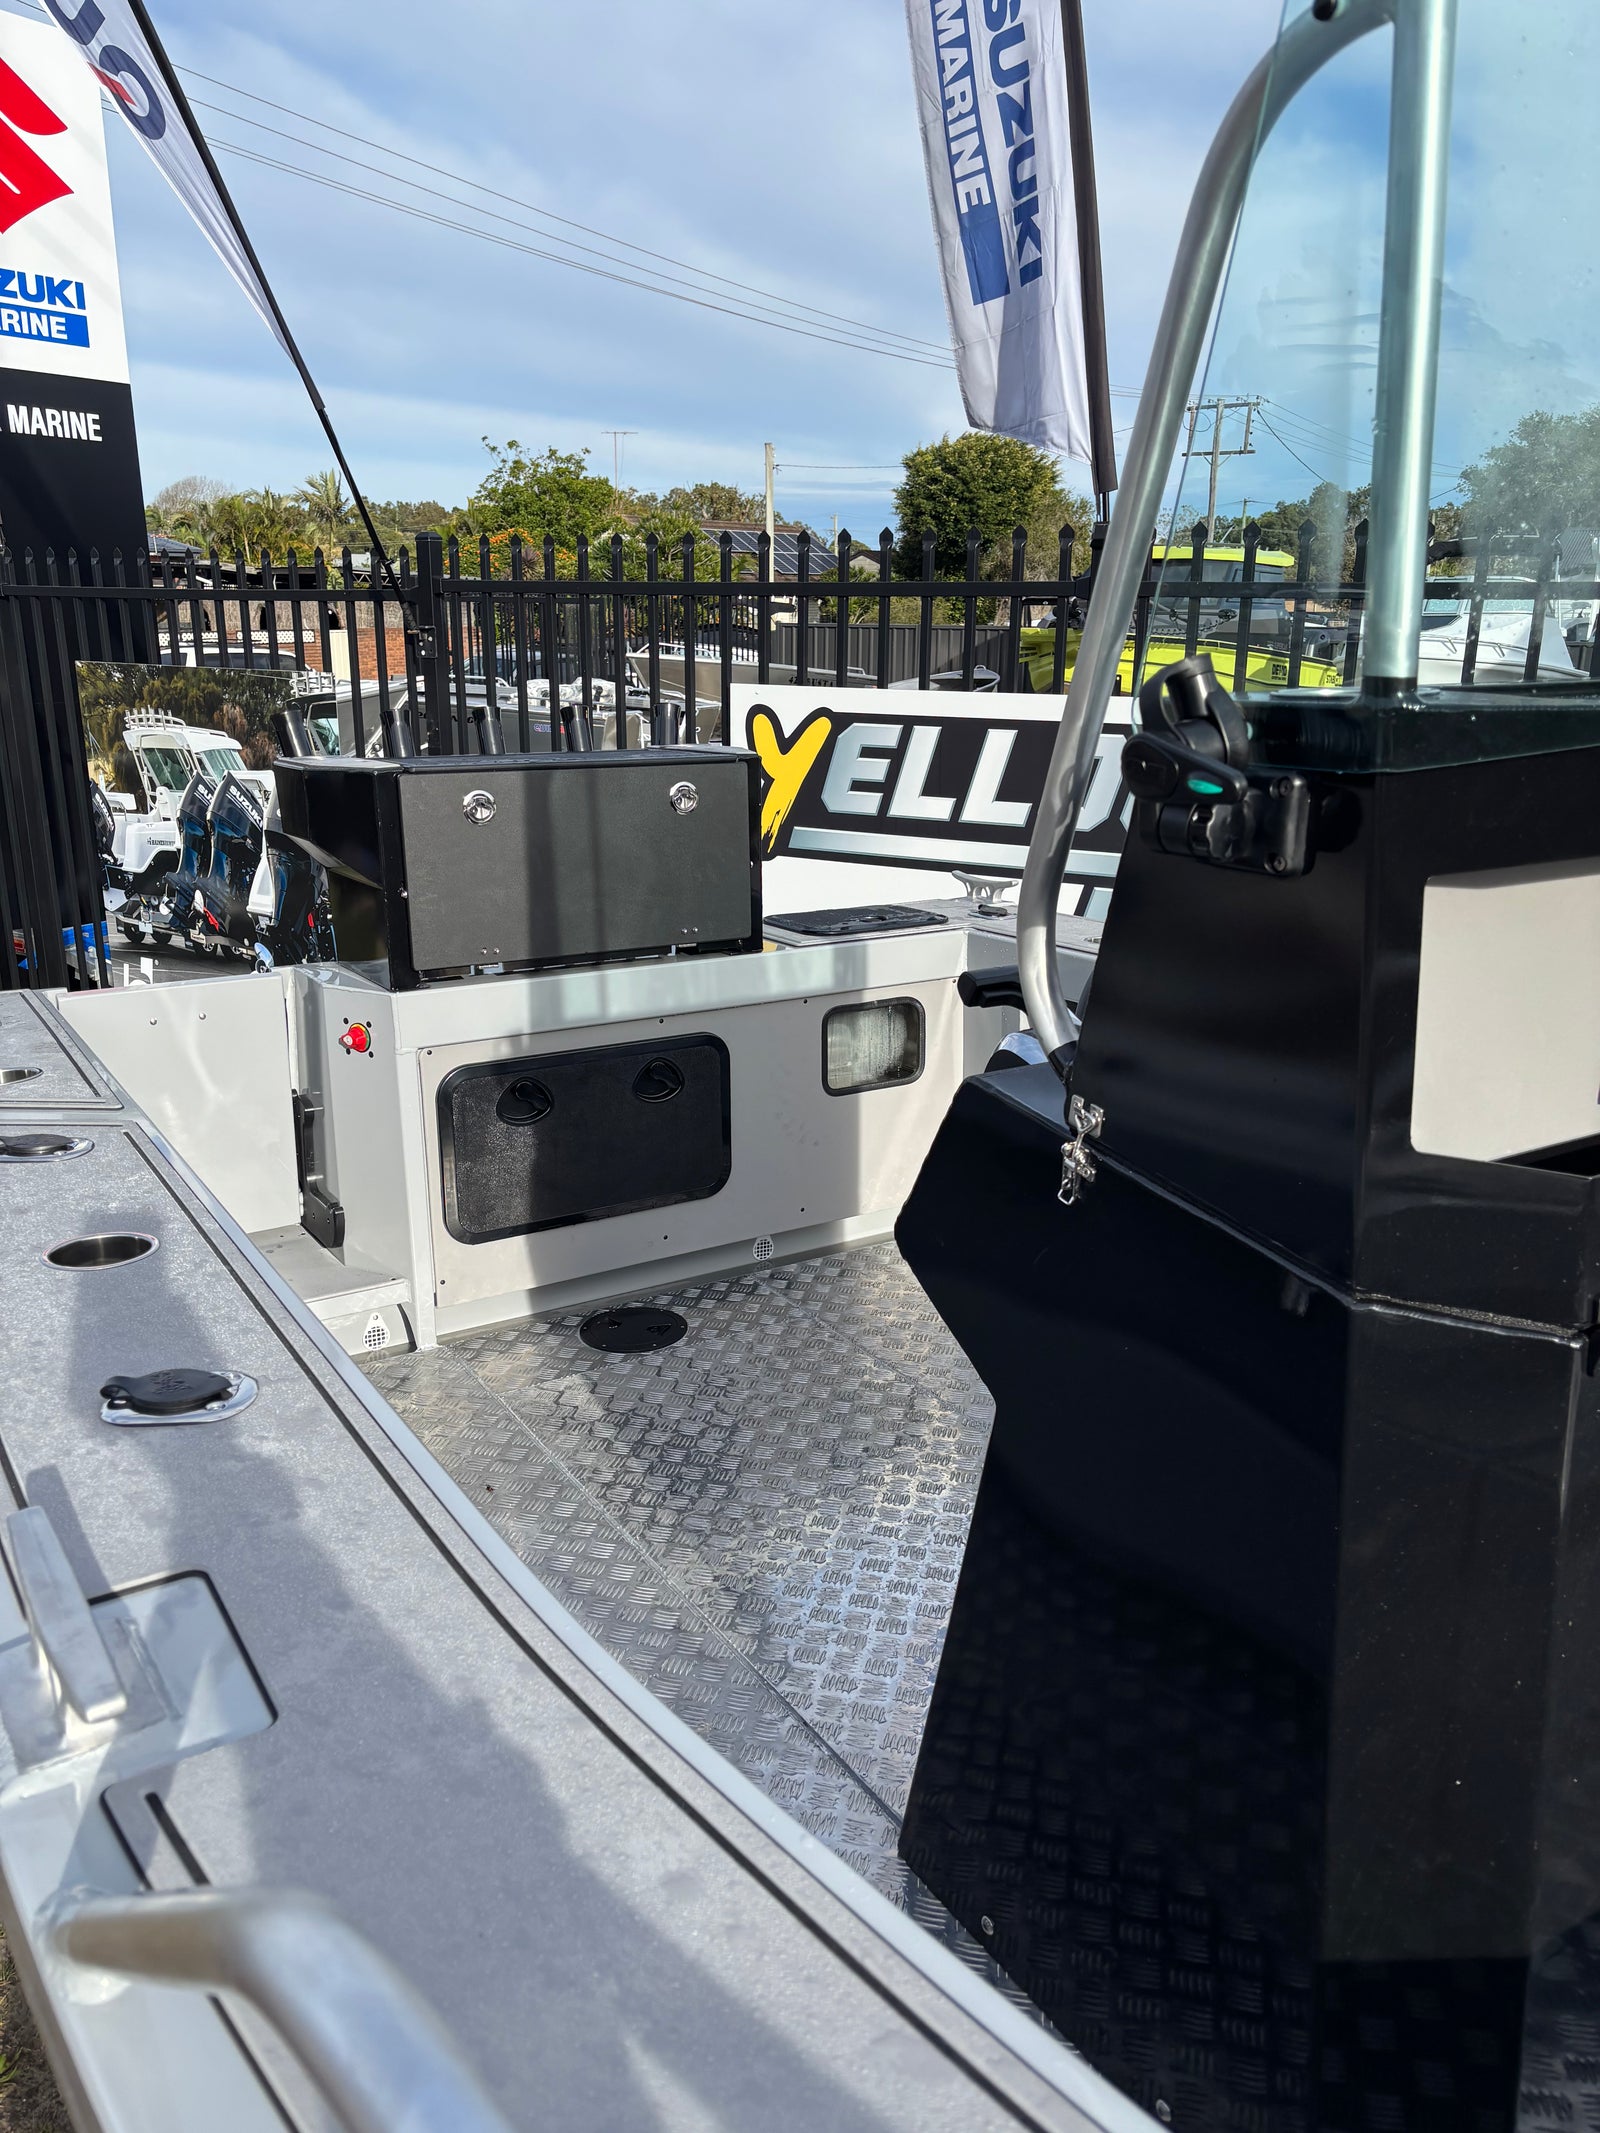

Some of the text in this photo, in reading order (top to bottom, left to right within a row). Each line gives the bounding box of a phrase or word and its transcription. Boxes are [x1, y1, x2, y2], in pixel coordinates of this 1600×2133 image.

[934, 0, 991, 214] MARINE
[0, 307, 68, 341] RINE
[7, 404, 103, 442] MARINE
[229, 785, 263, 828] SUZUKI
